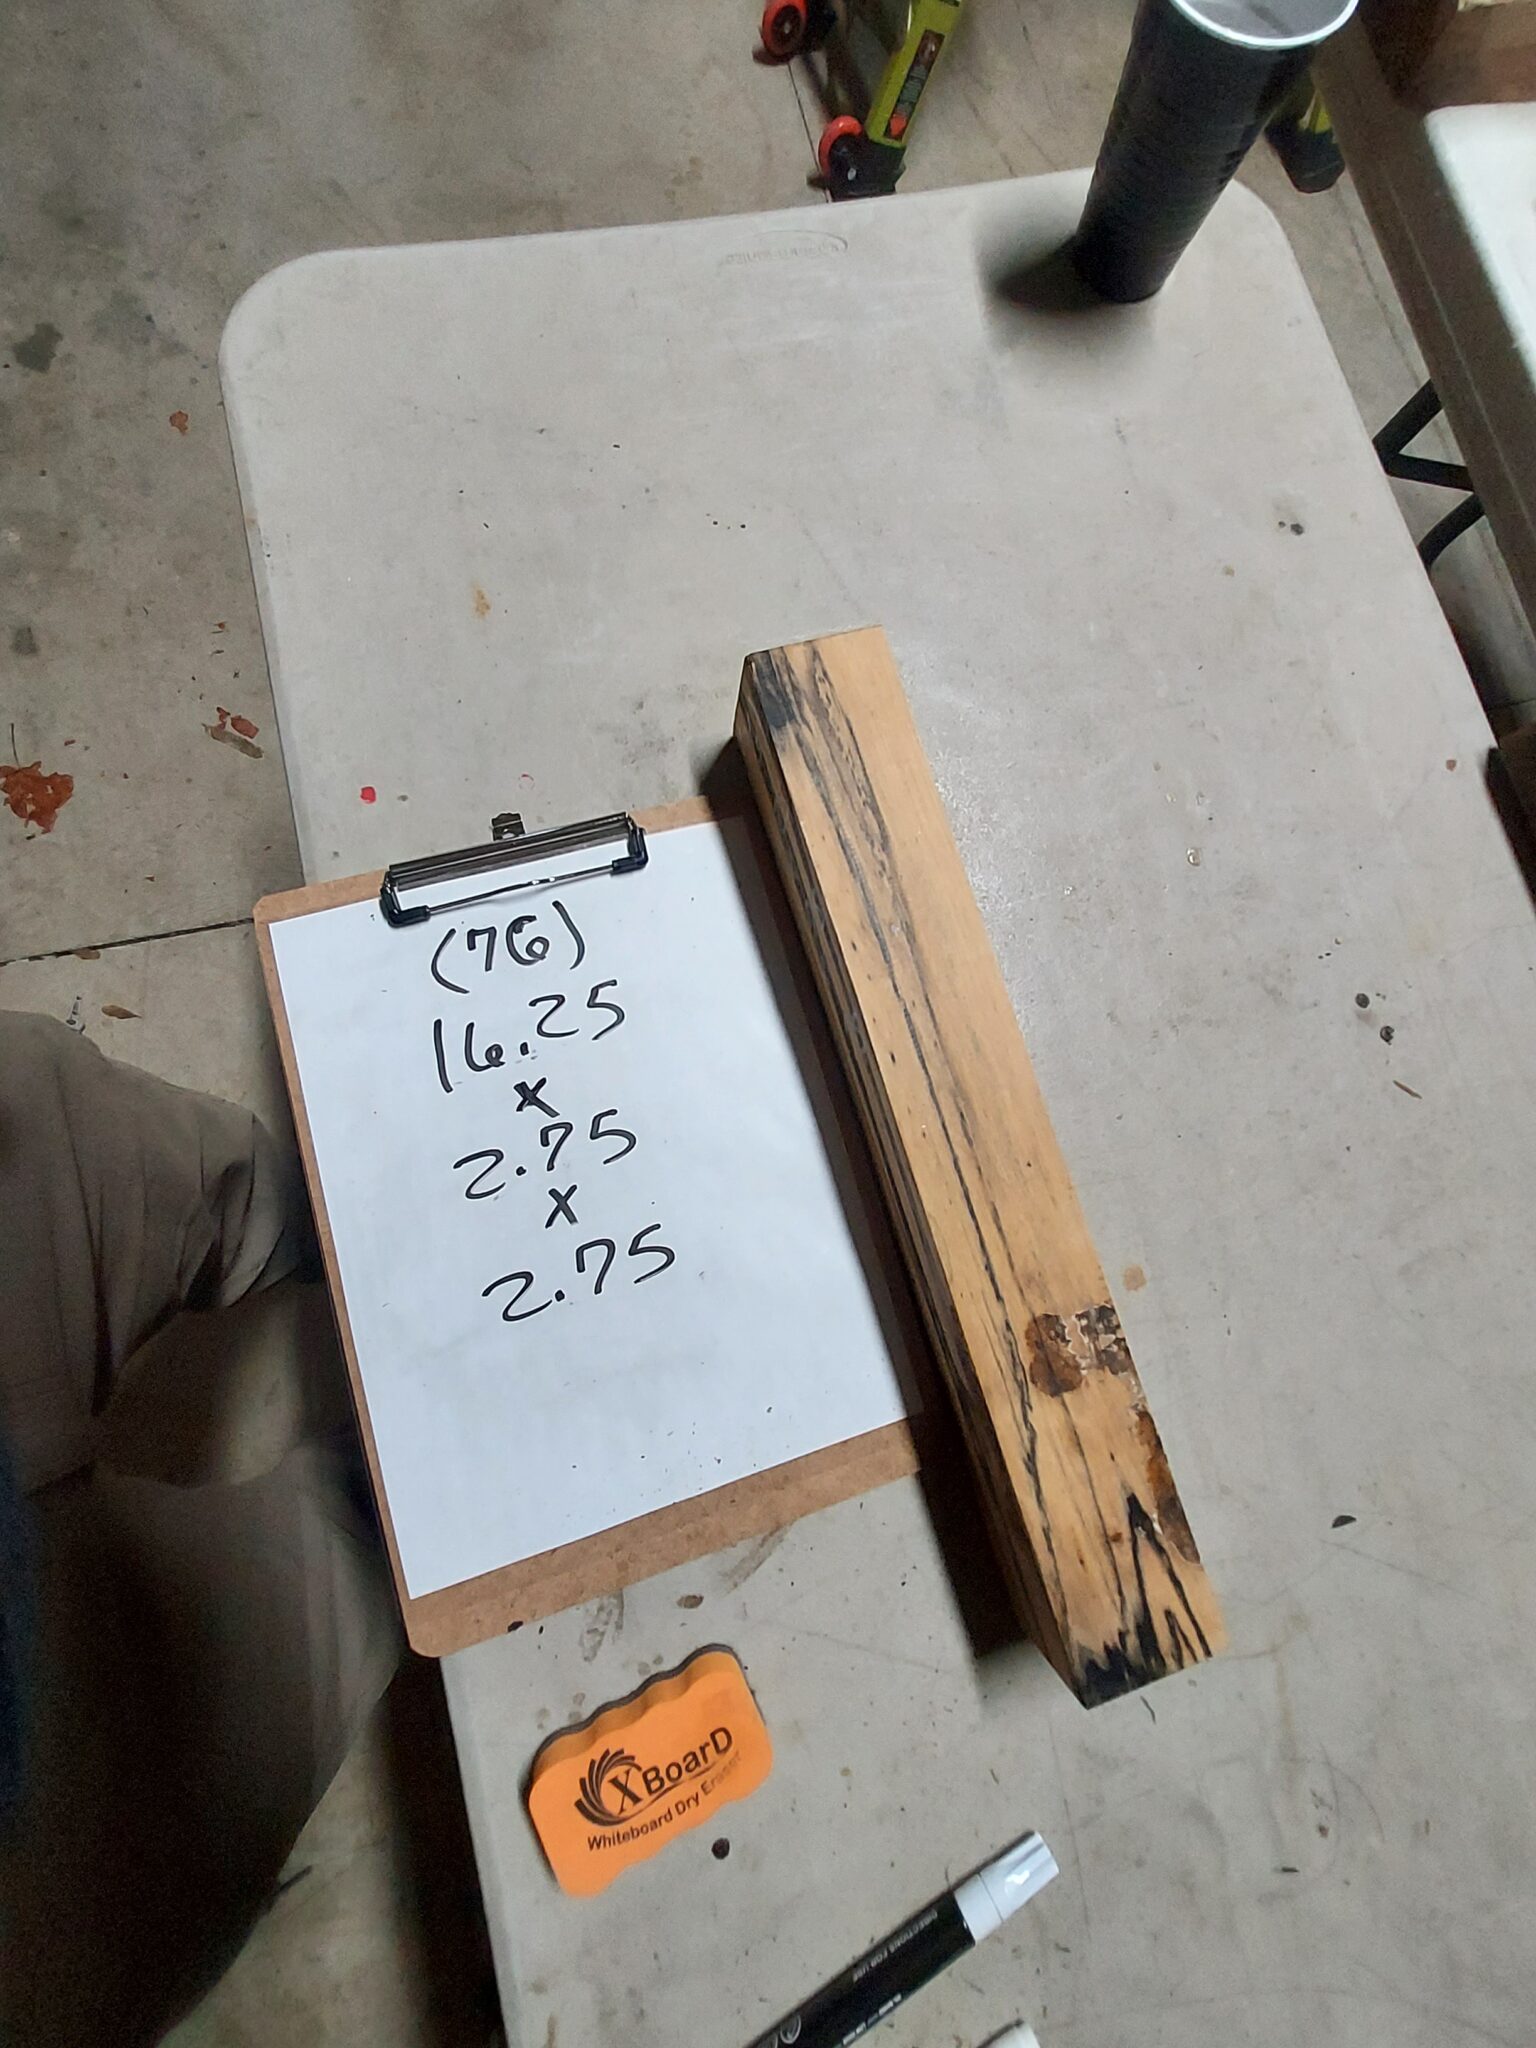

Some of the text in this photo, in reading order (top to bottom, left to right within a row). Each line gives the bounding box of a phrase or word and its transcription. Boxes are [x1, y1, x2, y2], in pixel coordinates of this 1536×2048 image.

[431, 900, 585, 994] (76)
[433, 979, 626, 1093] 16.25
[453, 1108, 637, 1199] 2.75
[481, 1223, 676, 1322] 2.75
[587, 1808, 673, 1851] Whiteboard
[675, 1792, 700, 1815] Dry
